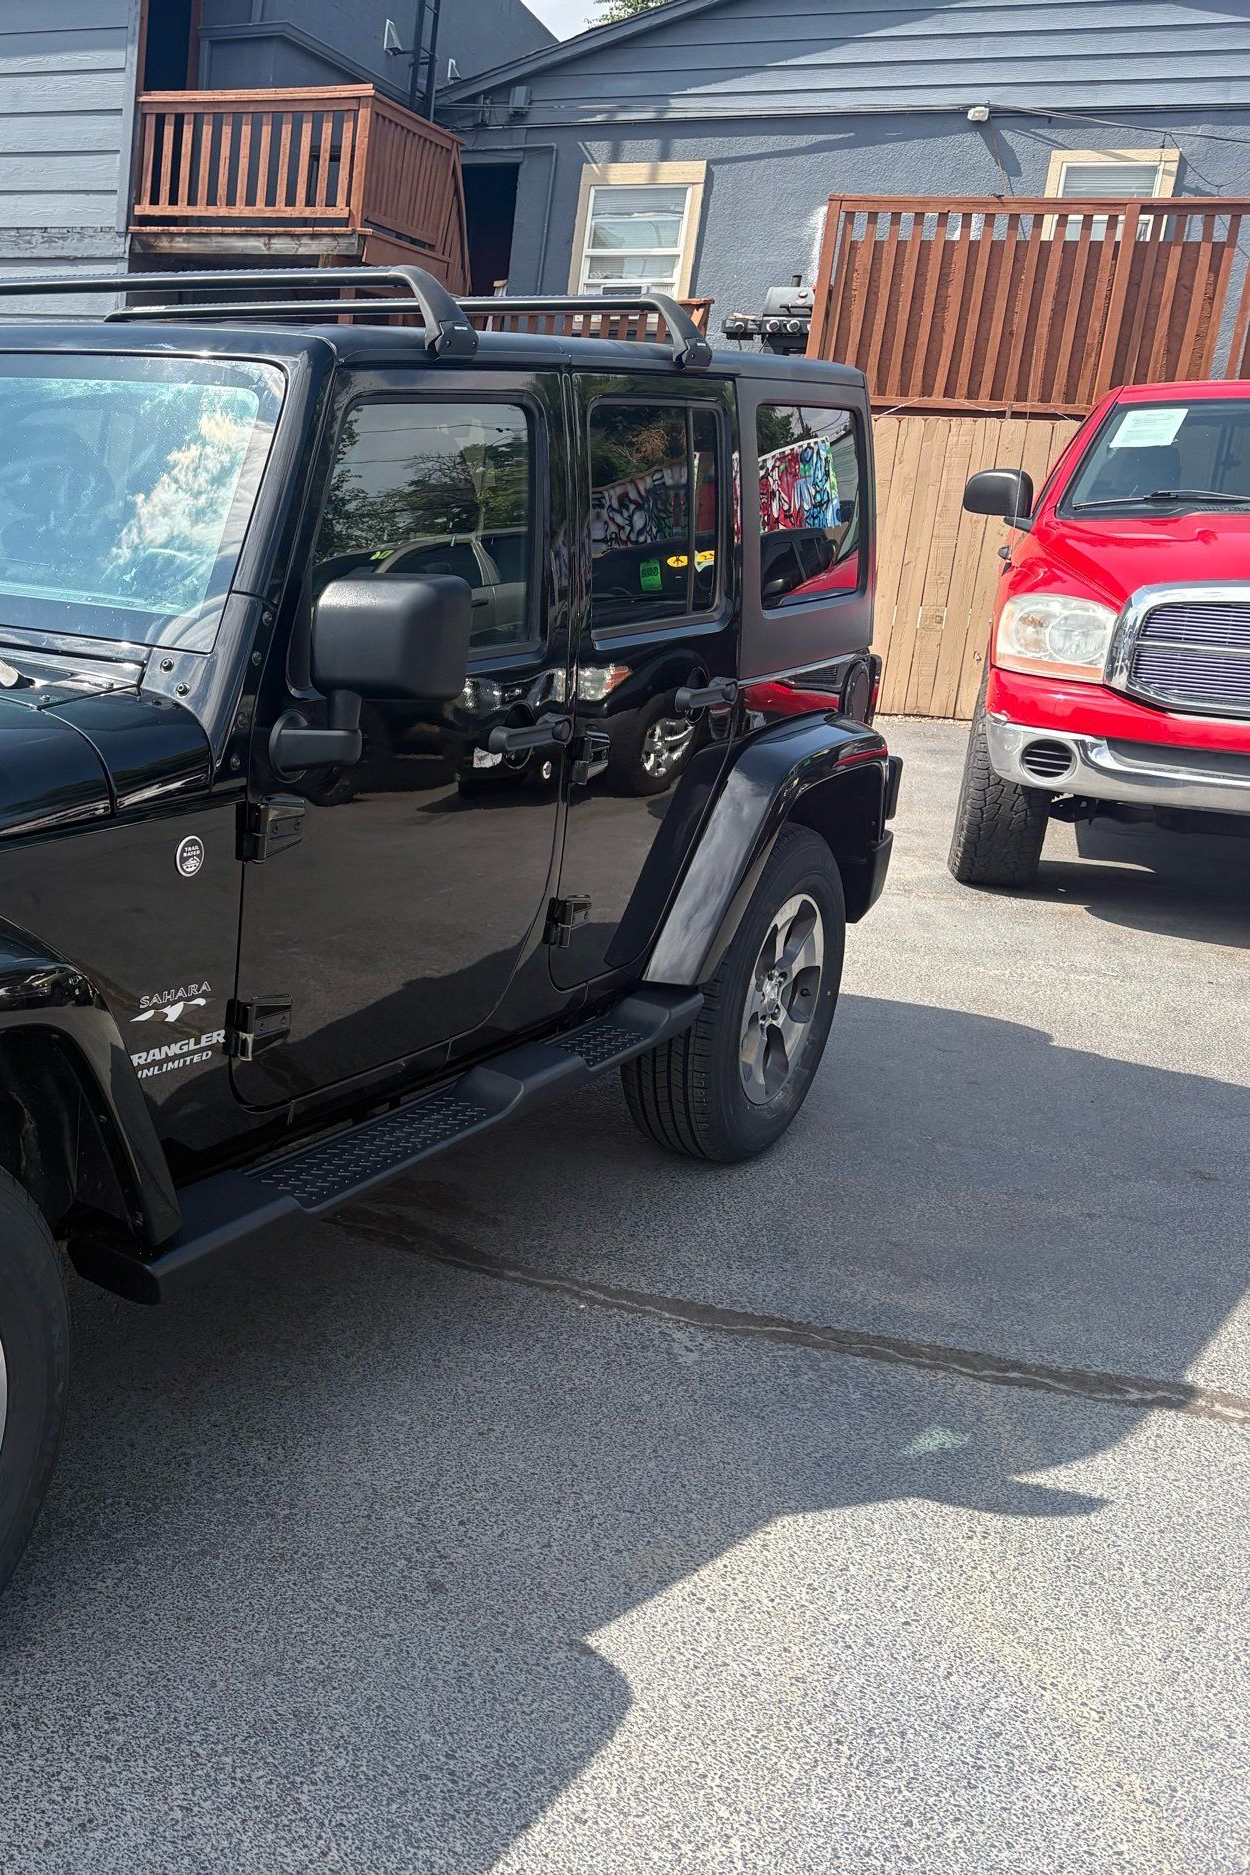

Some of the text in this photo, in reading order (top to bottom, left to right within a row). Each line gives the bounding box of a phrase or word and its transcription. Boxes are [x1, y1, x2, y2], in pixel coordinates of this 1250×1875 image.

[184, 844, 200, 852] TRAIL
[139, 981, 211, 1008] SAHARA
[130, 1029, 226, 1067] RANGLER
